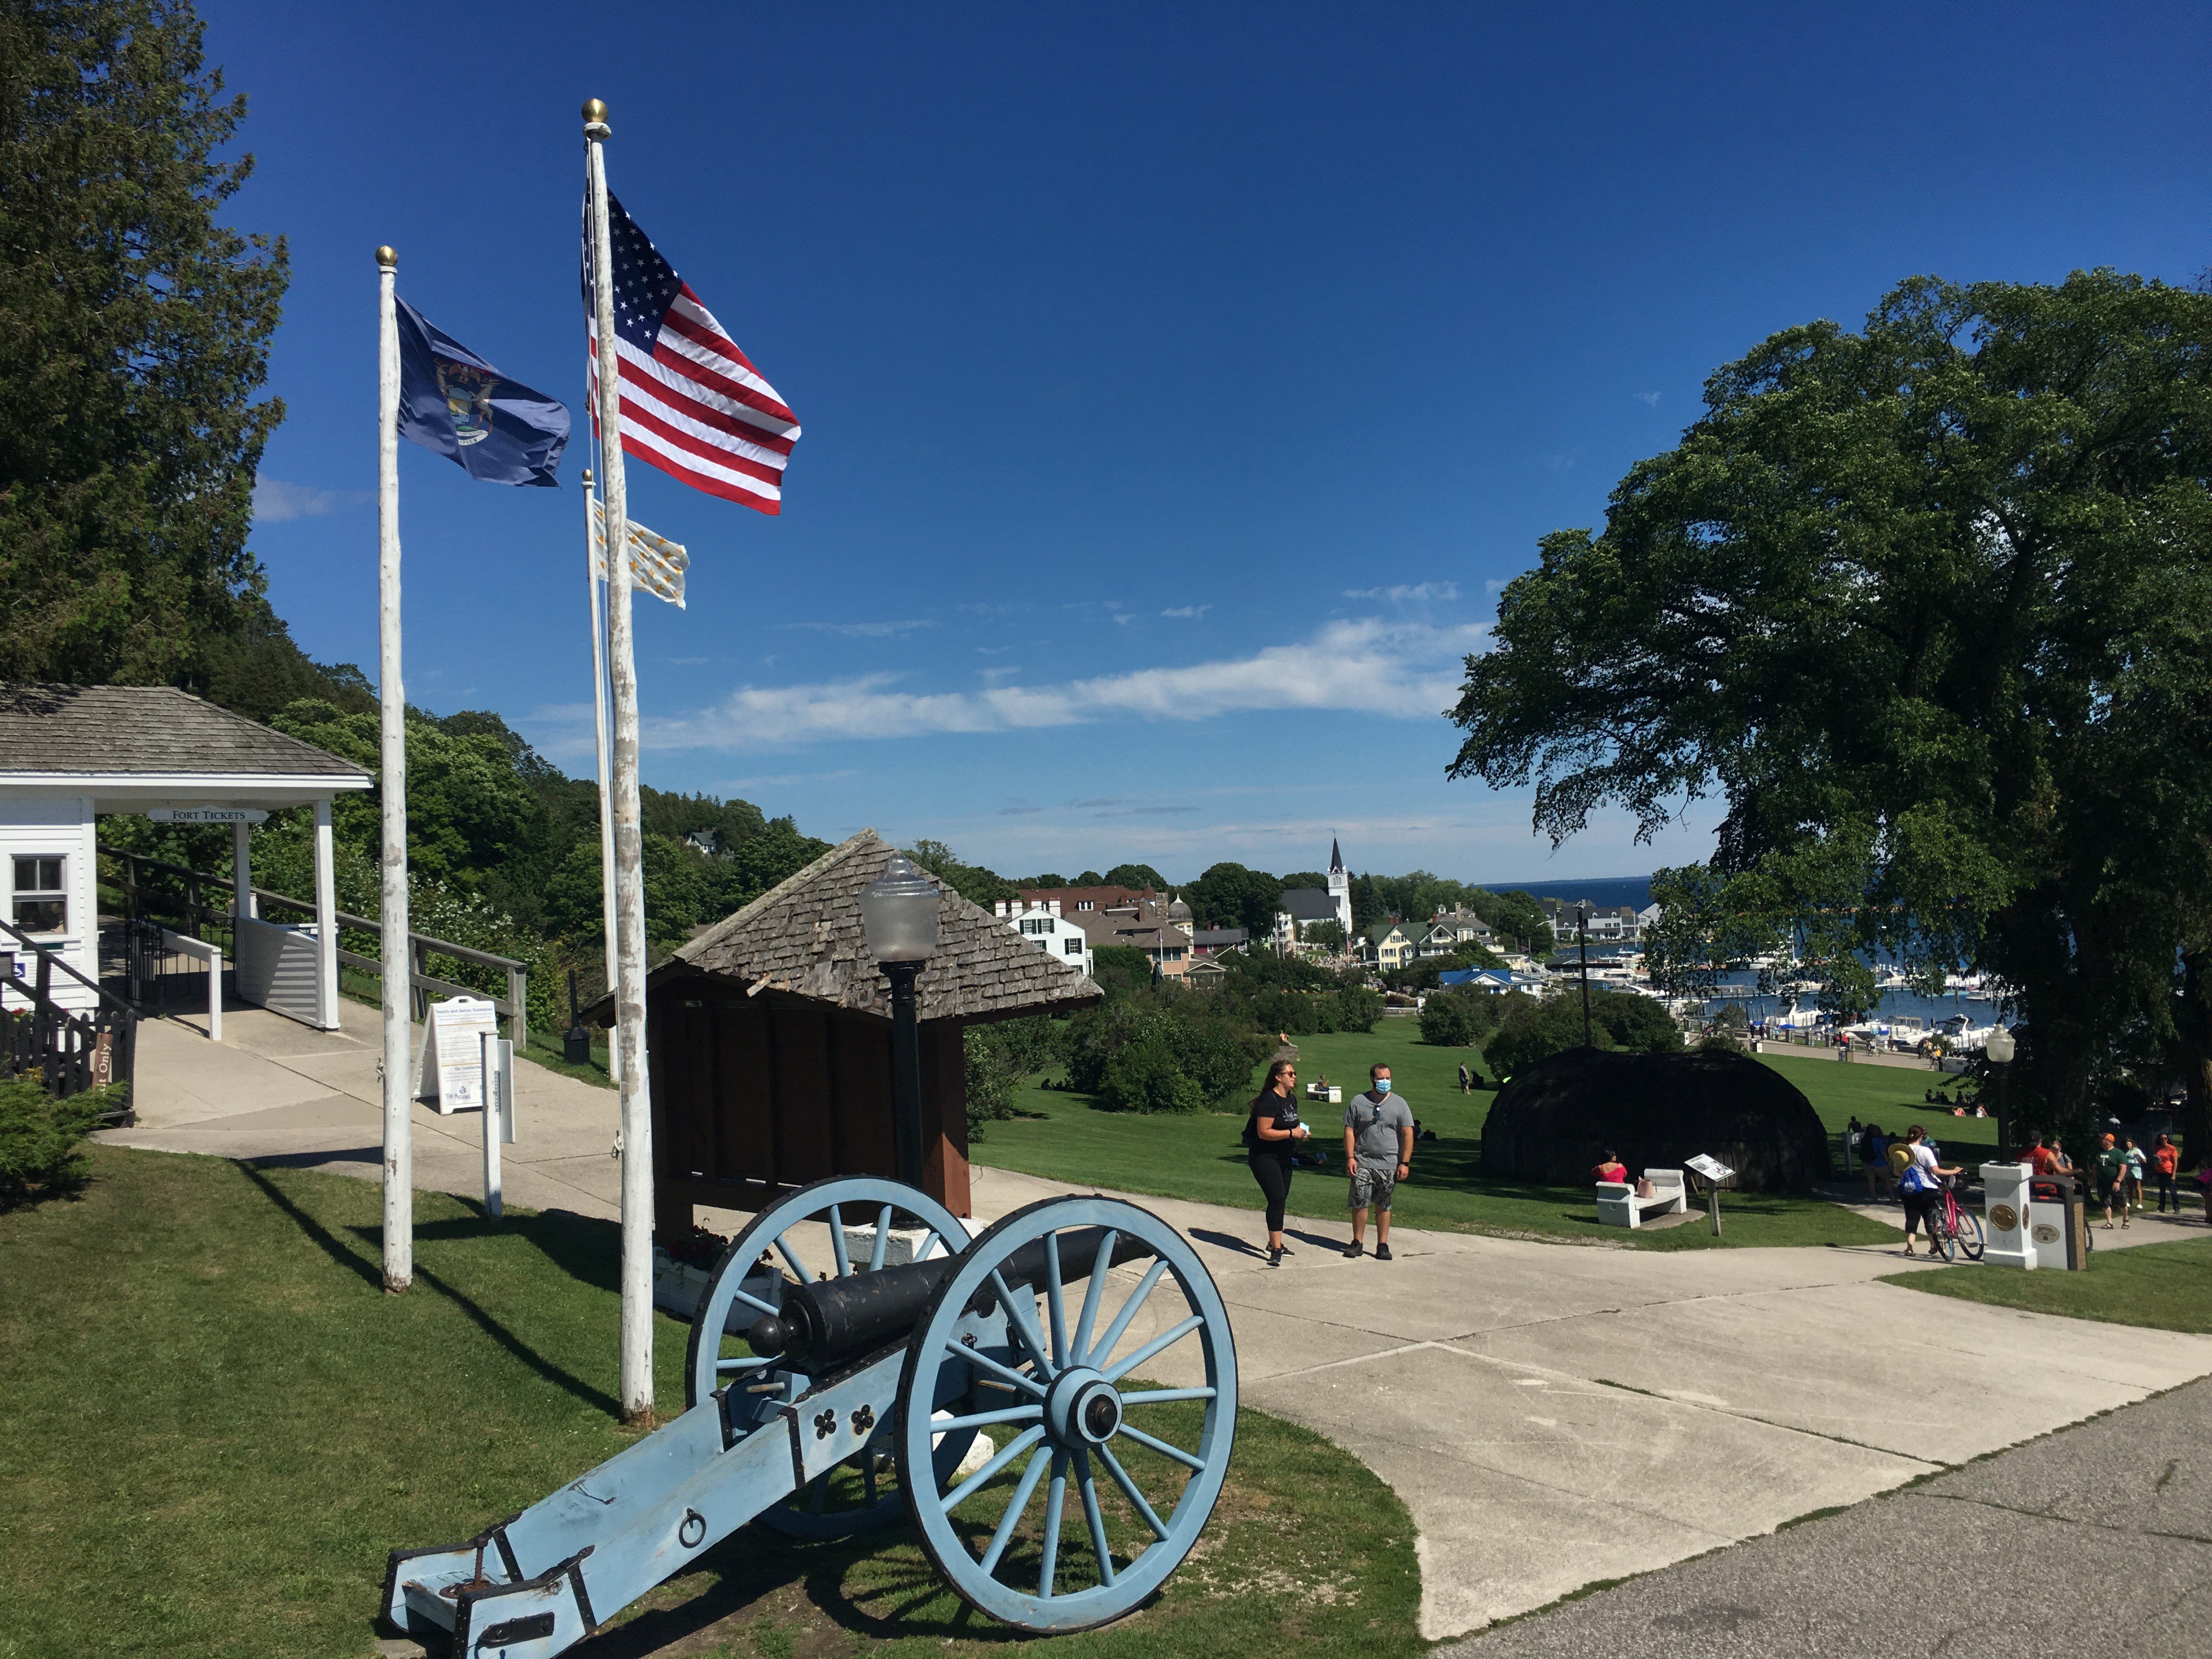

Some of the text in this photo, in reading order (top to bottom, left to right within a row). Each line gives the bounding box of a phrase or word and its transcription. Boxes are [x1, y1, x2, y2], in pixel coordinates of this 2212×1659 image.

[173, 810, 245, 819] FORT TICKETS
[99, 1043, 112, 1073] Only
